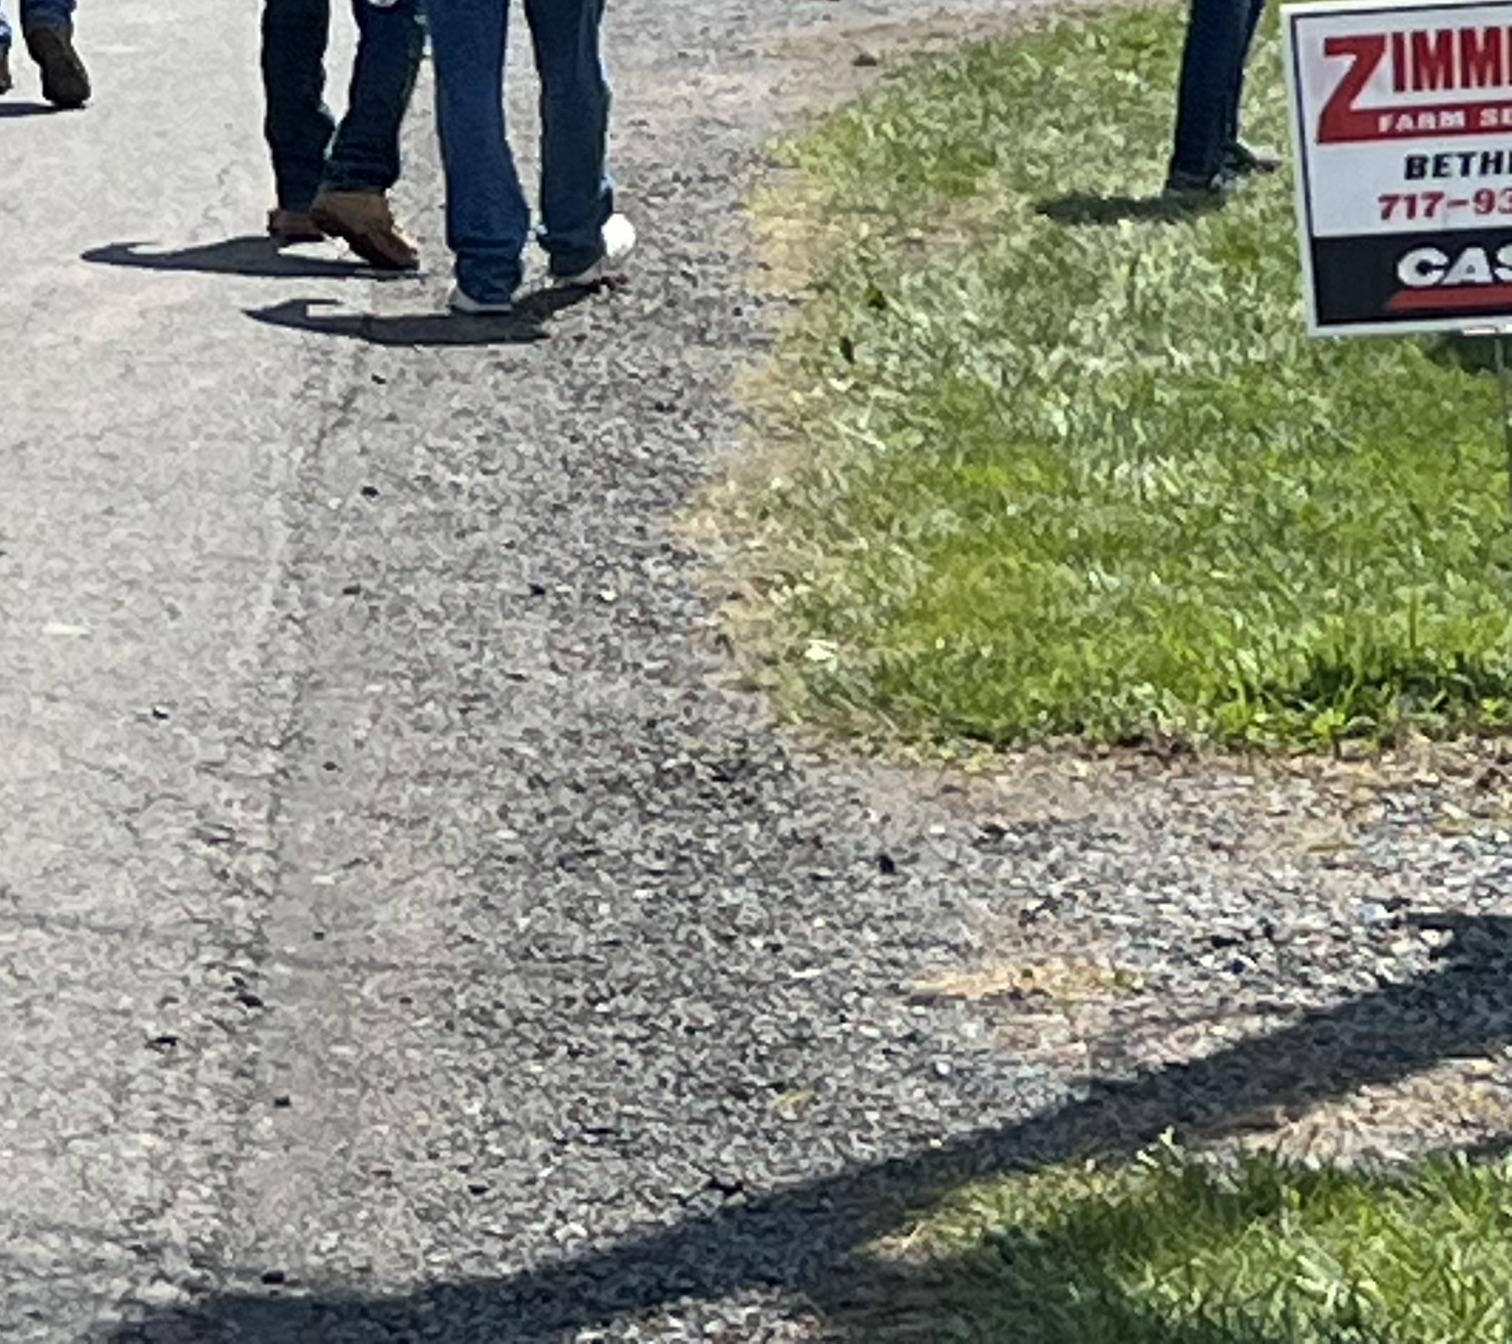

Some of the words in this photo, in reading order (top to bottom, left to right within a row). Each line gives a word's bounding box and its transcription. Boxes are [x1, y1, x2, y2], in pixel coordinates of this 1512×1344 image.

[1316, 26, 1512, 144] ZIMM
[1378, 110, 1467, 134] FARM
[1403, 150, 1512, 181] BETH
